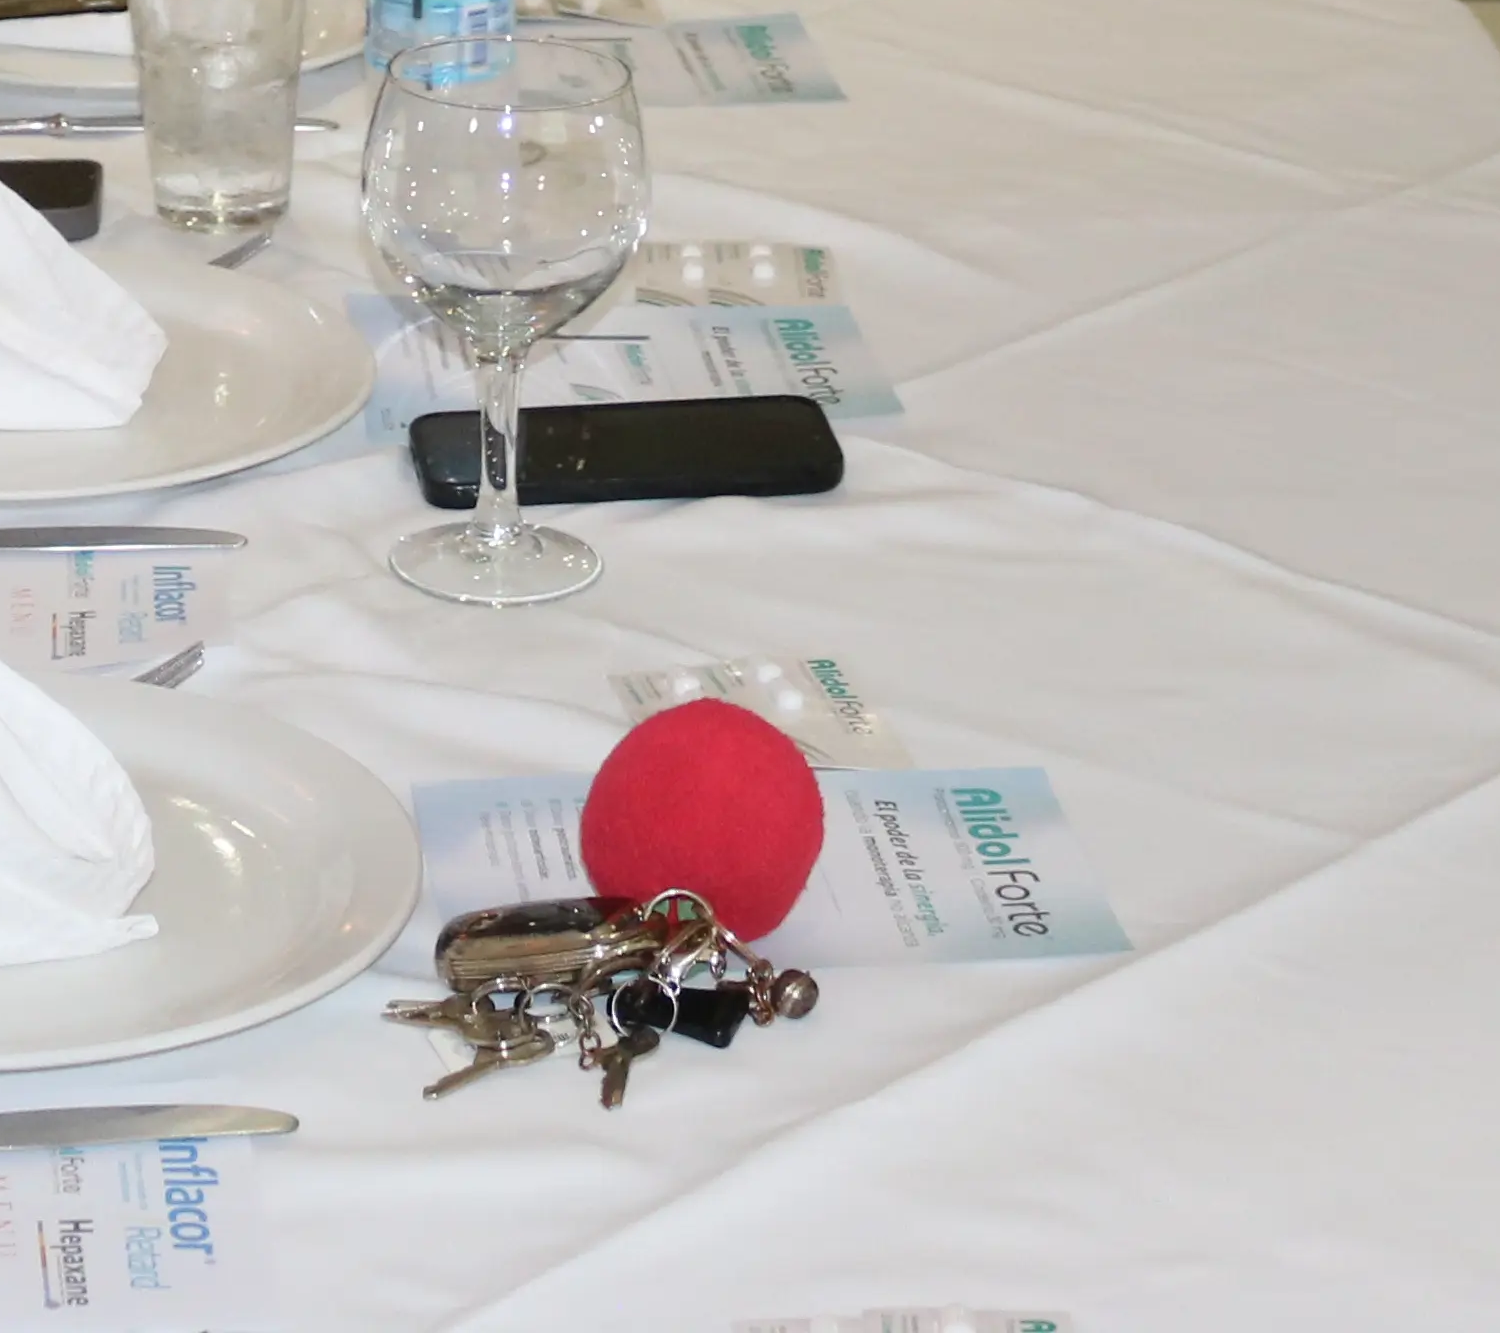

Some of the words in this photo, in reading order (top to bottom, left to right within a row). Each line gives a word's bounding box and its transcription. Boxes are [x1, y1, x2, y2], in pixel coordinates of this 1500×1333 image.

[774, 318, 832, 366] Alidol
[152, 565, 196, 623] Inflacor
[807, 659, 859, 700] Alidol
[874, 800, 898, 812] El
[951, 788, 1031, 866] Alidol
[873, 812, 911, 849] poder
[862, 835, 898, 898] monoterapia
[897, 851, 919, 867] de
[904, 868, 925, 882] la
[987, 870, 1050, 937] Forte
[60, 1156, 85, 1195] Forte
[157, 1137, 219, 1256] Inflacor
[50, 1219, 94, 1307] Hepaxane
